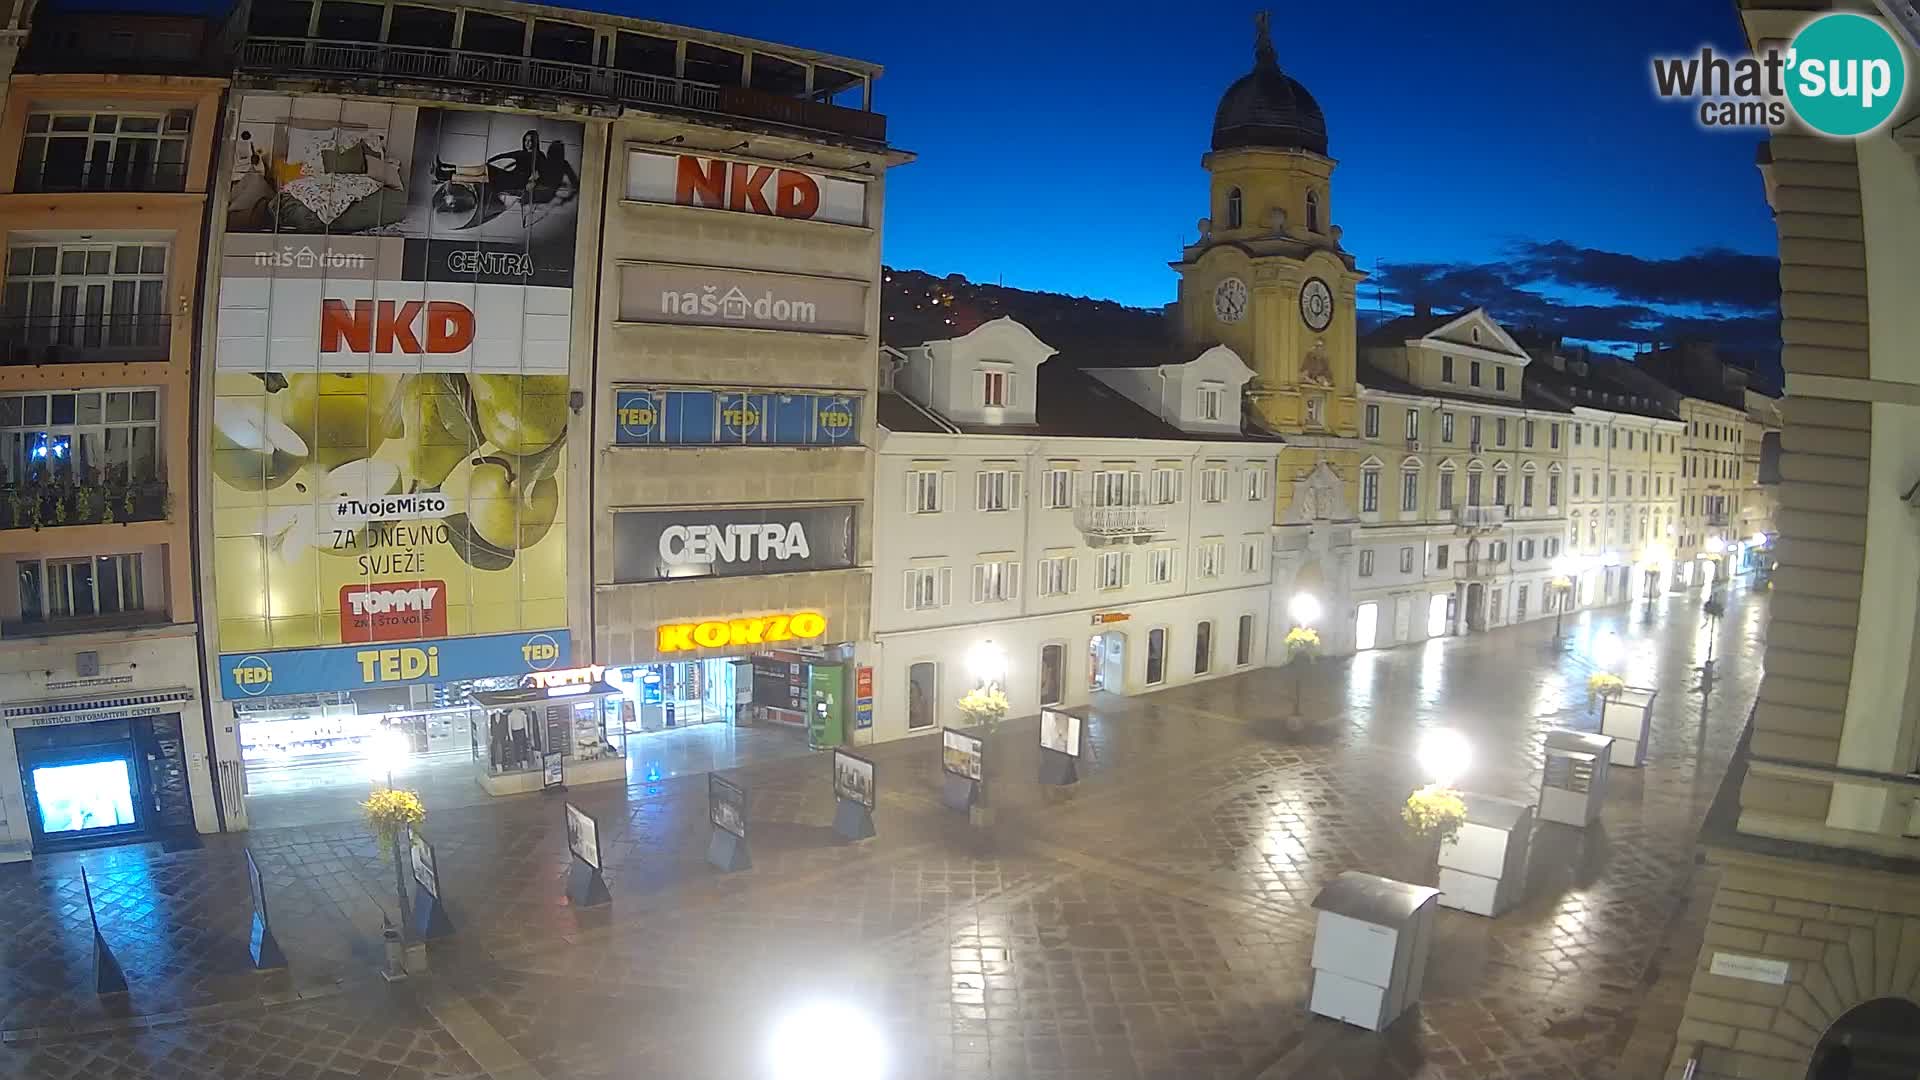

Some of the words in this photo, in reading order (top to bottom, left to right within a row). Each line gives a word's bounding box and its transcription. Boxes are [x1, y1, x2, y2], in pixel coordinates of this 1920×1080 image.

[675, 155, 820, 219] NKD
[319, 247, 365, 269] dom
[447, 250, 535, 276] CENTRA
[661, 284, 718, 316] naš
[753, 290, 816, 323] dom
[320, 299, 476, 354] NKD
[618, 408, 658, 426] TEDi
[723, 409, 760, 427] TEDi
[819, 410, 853, 428] TEDi
[337, 497, 446, 517] #TvojeMisto
[333, 529, 357, 550] ZA
[367, 524, 450, 548] DNEVNO
[658, 521, 811, 563] CENTRA
[358, 548, 425, 576] SVJEŽE
[347, 587, 438, 615] TOMMY
[402, 610, 431, 624] VOLŠ
[657, 612, 826, 652] KORZO
[357, 646, 440, 684] TEDi
[521, 643, 559, 662] TEDi
[232, 666, 273, 685] TEDi
